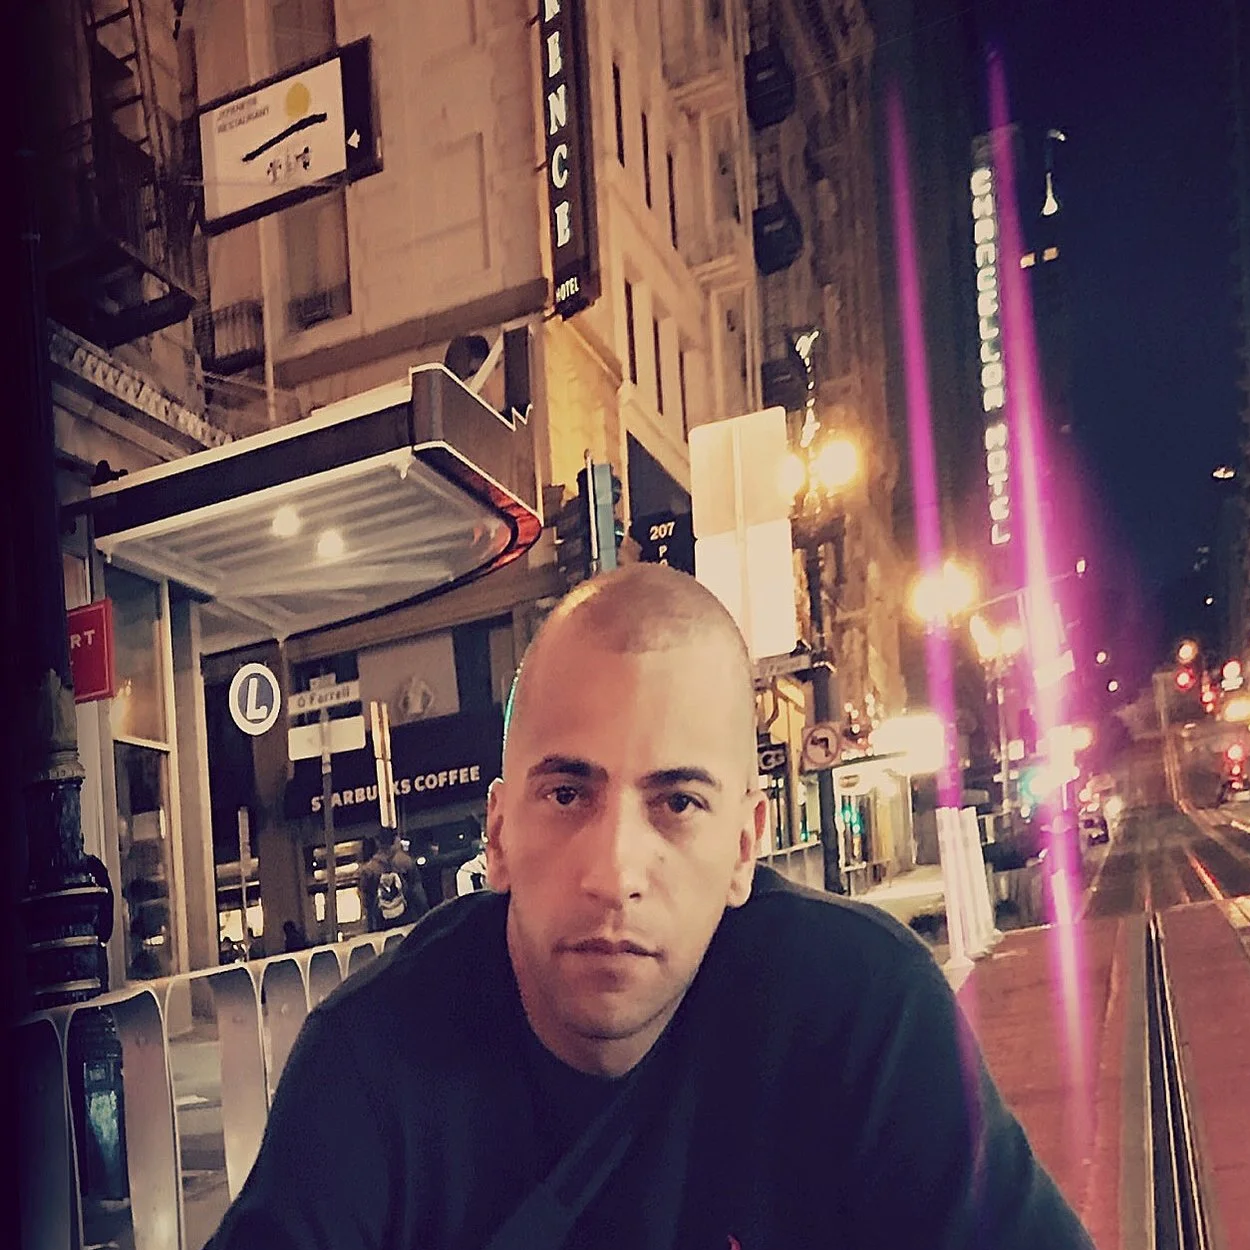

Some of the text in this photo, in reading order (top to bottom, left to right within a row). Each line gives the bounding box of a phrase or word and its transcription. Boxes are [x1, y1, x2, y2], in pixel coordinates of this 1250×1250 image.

[555, 276, 580, 303] HOTEL
[984, 422, 1012, 546] HOTEL
[649, 521, 676, 541] 207
[311, 765, 481, 813] SARBUKS COFFEE
